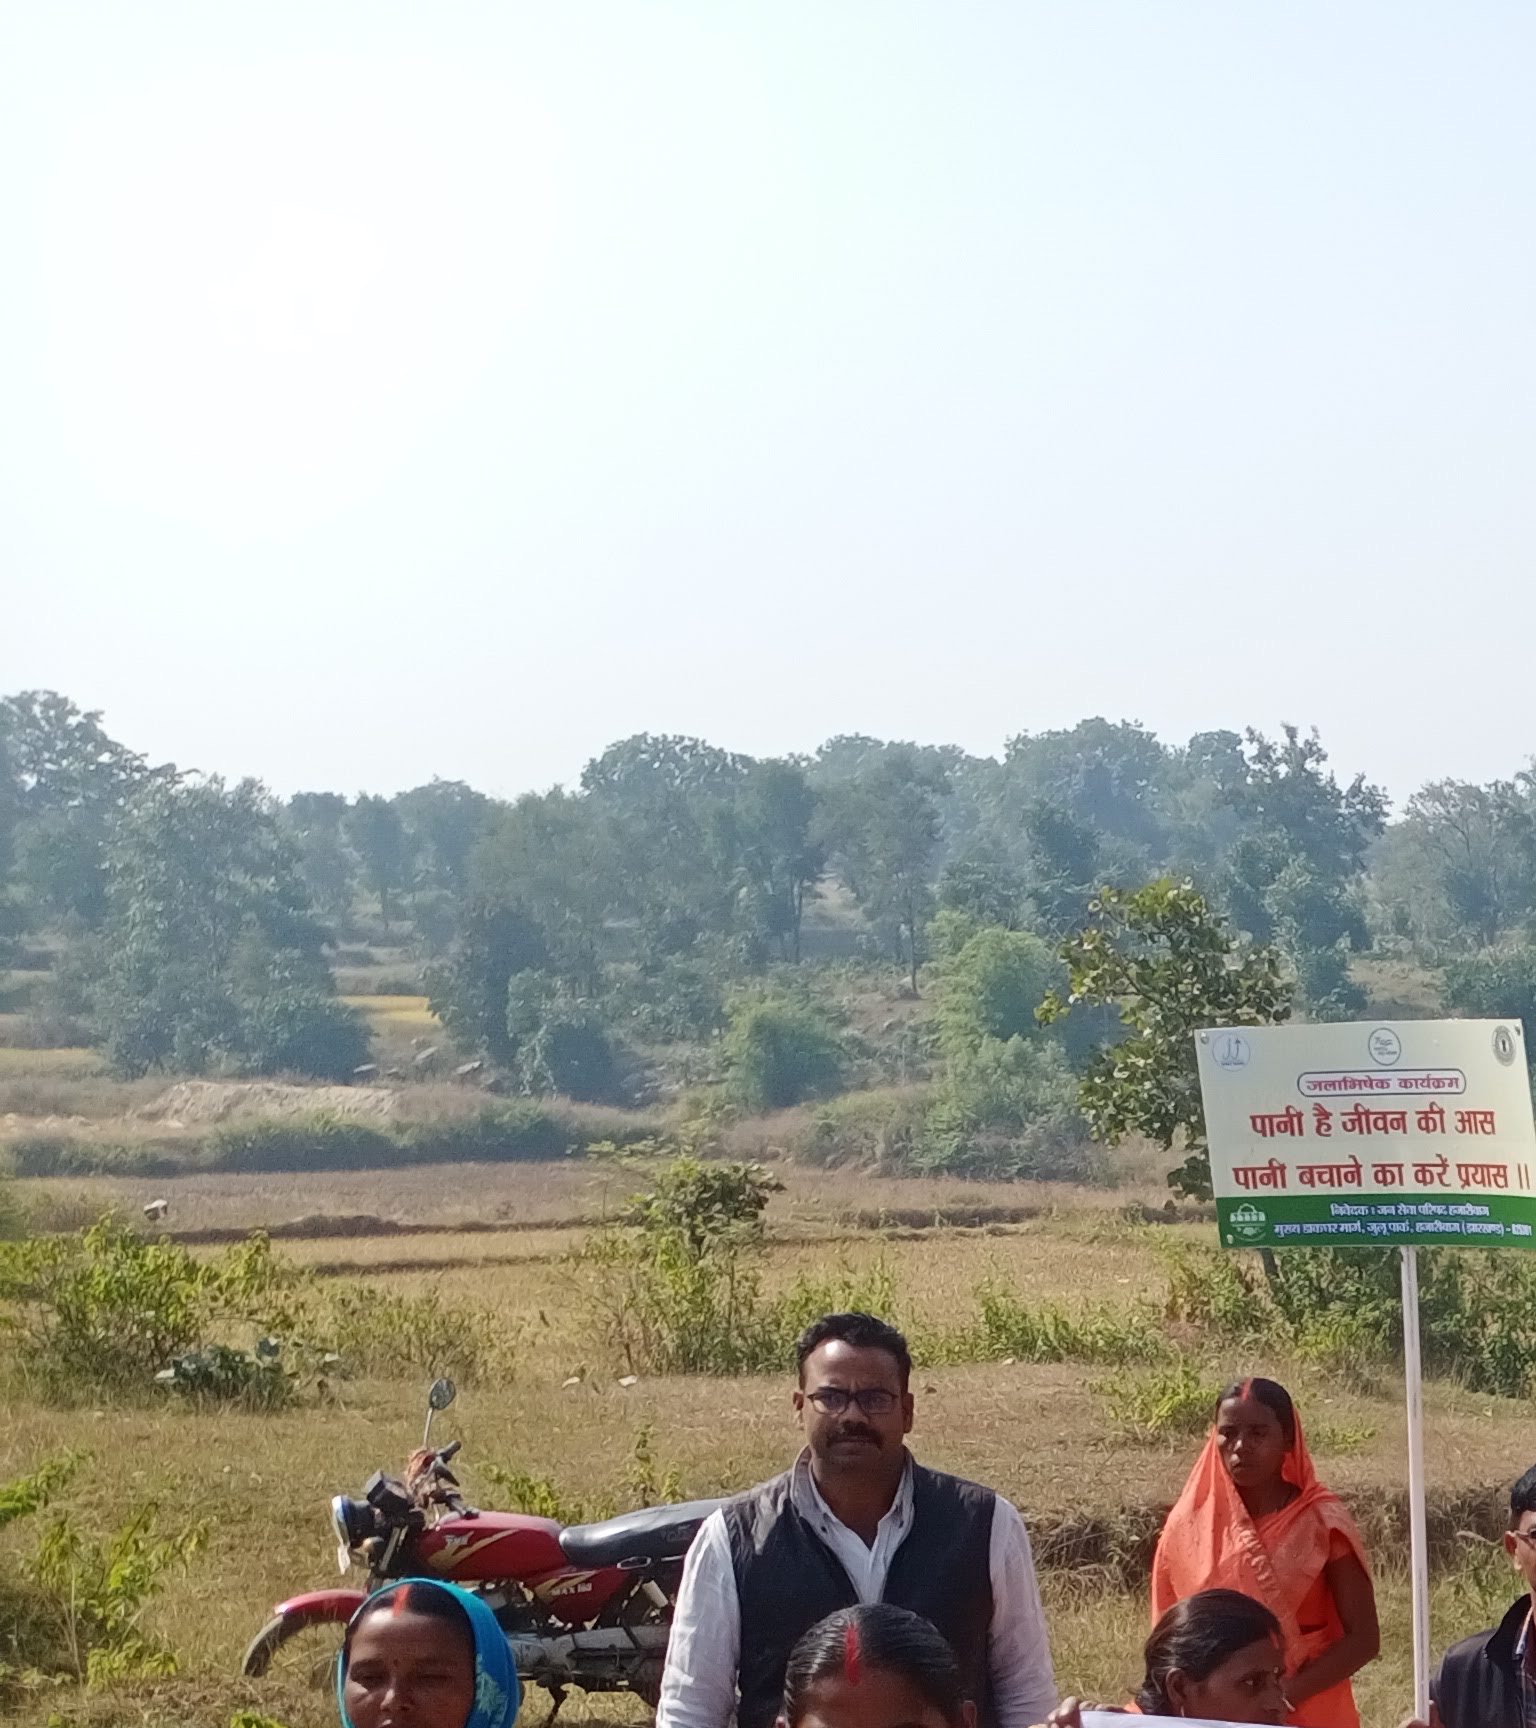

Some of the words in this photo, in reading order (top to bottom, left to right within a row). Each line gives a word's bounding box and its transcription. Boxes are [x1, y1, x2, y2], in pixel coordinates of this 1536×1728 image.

[1306, 1074, 1391, 1092] जलाभिषेक
[1398, 1072, 1460, 1090] कार्यक्रम
[1250, 1105, 1304, 1137] पानी
[1313, 1103, 1332, 1137] है
[1340, 1103, 1408, 1136] जीवन
[1415, 1101, 1445, 1134] की
[1455, 1110, 1495, 1135] आस
[1233, 1158, 1287, 1189] पानी
[1296, 1154, 1362, 1188] बचाने
[1371, 1163, 1404, 1188] का
[1412, 1154, 1451, 1187] करें
[1457, 1163, 1508, 1189] प्रयास
